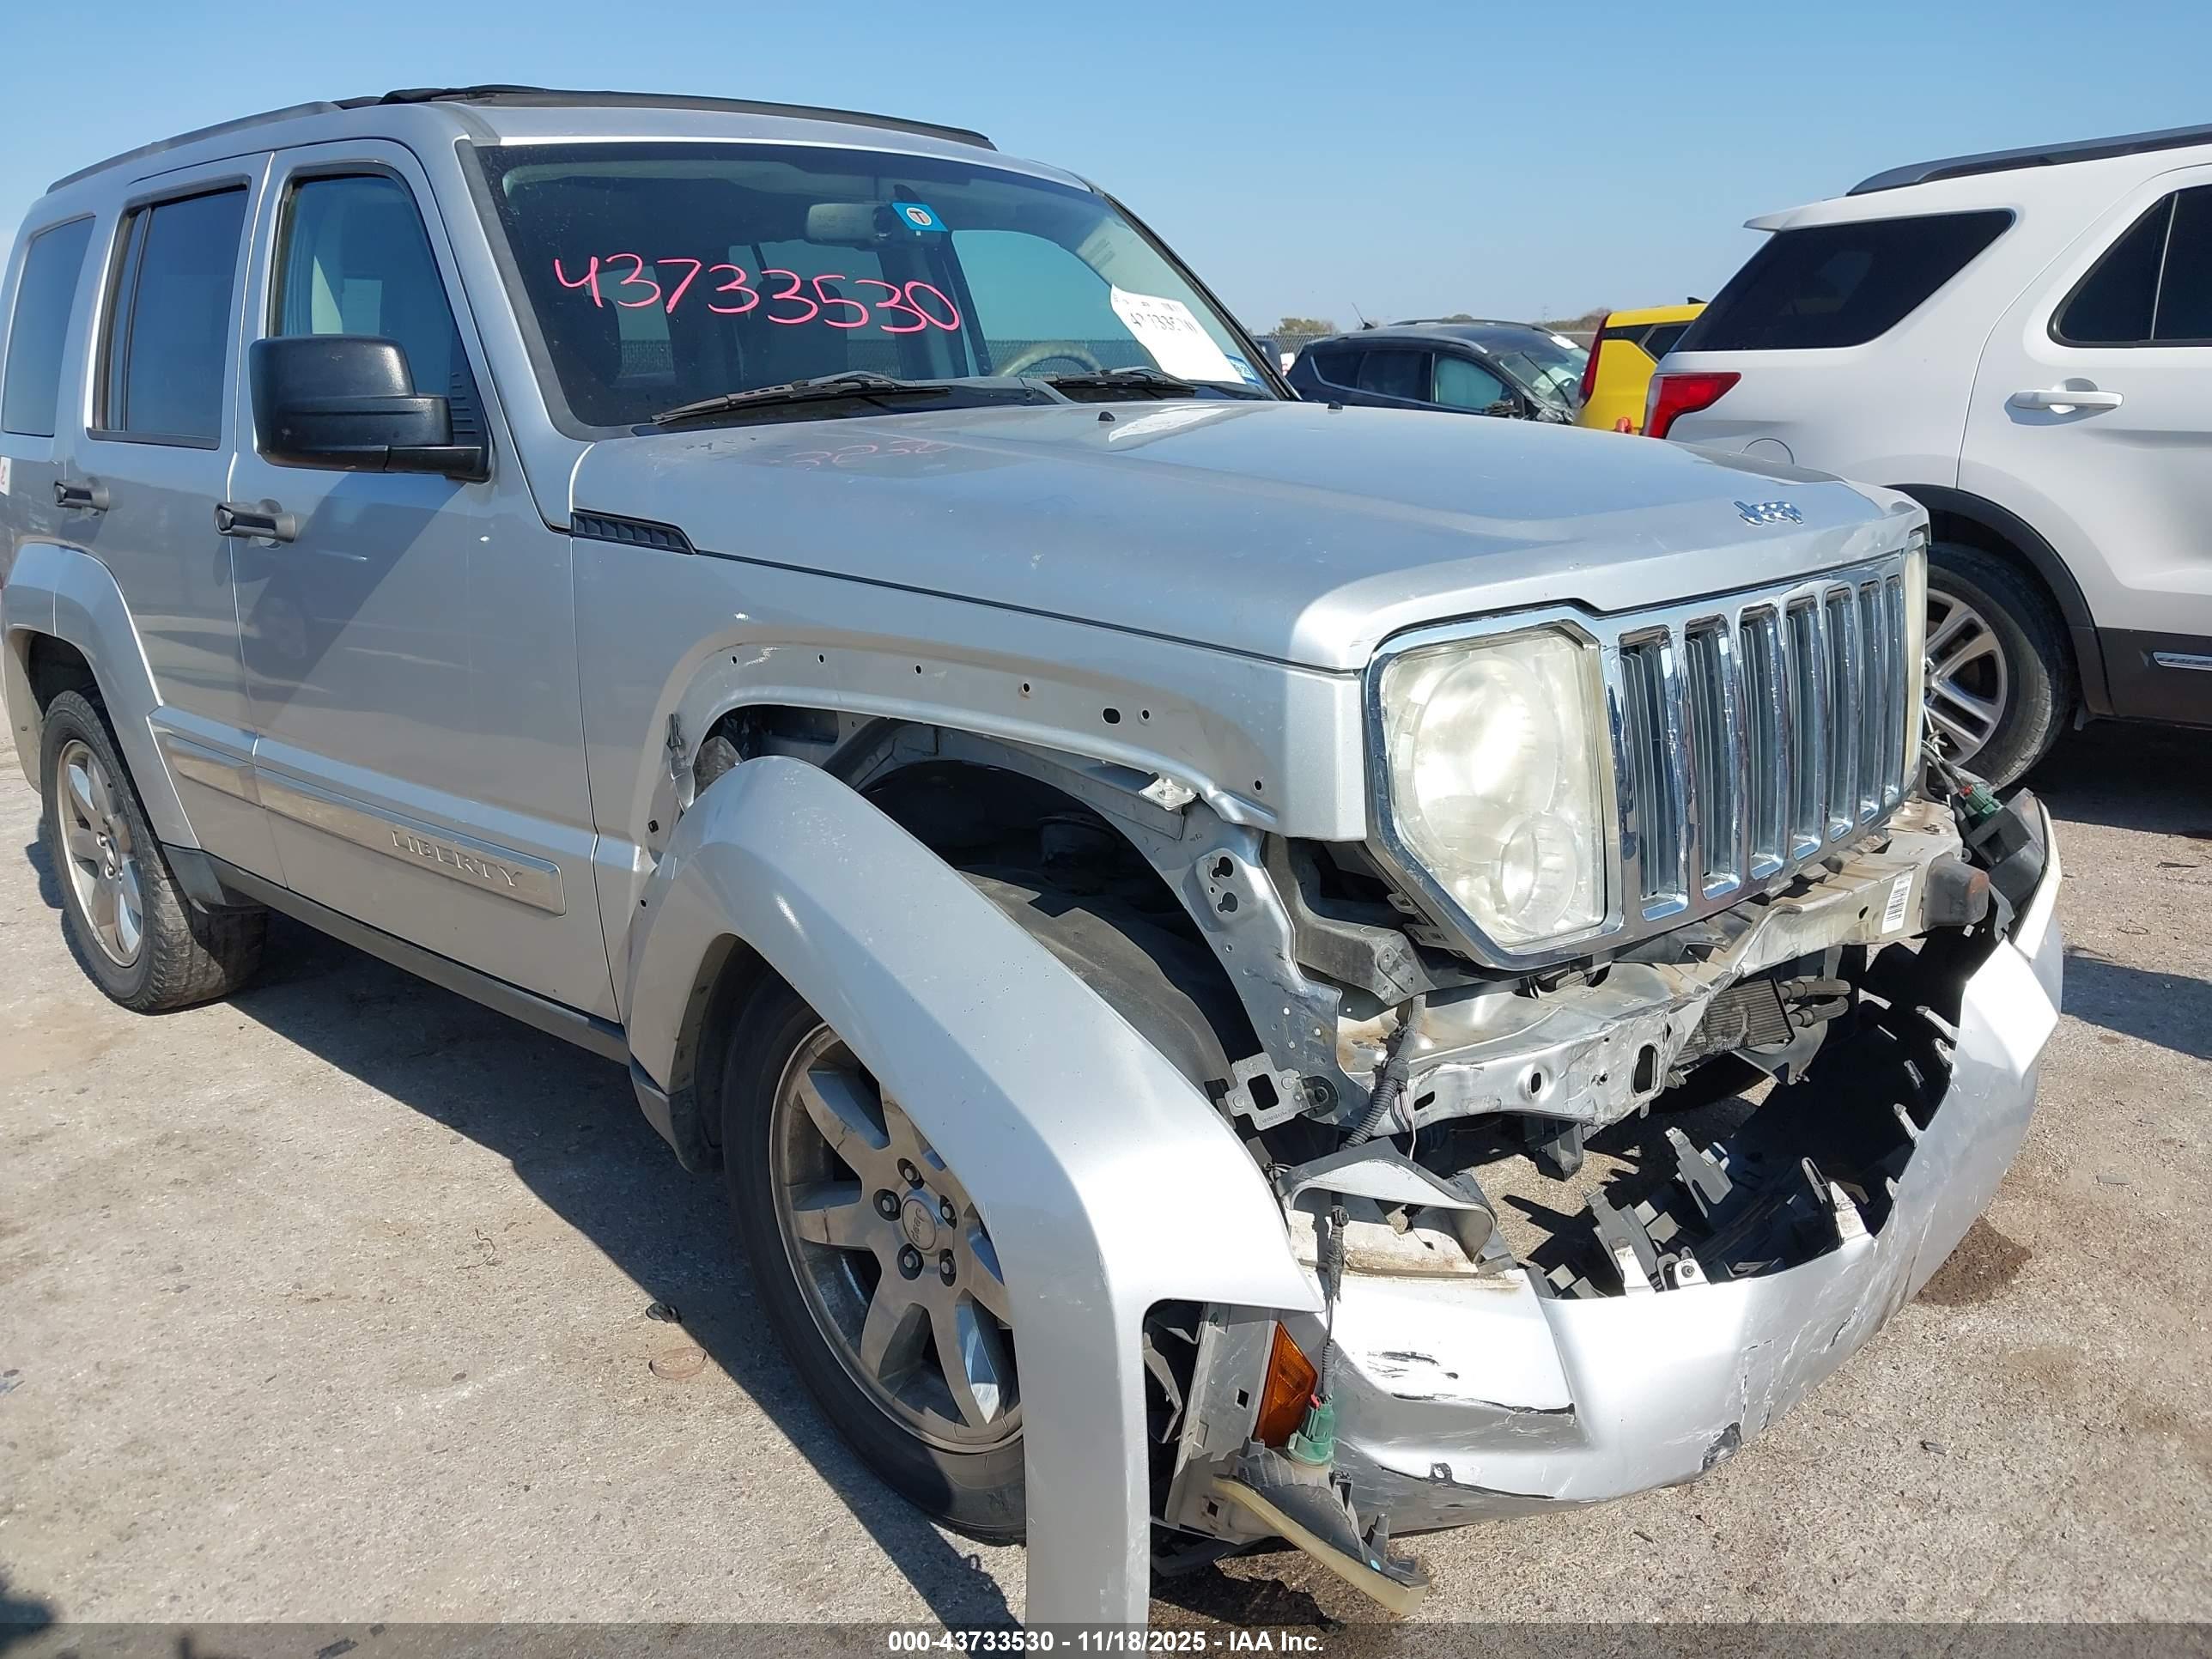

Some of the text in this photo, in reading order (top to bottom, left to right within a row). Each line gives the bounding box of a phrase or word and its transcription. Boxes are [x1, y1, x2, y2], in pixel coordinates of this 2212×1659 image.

[554, 252, 960, 333] 43733530
[1733, 501, 1804, 526] Jeep
[392, 830, 522, 887] LIBERTY
